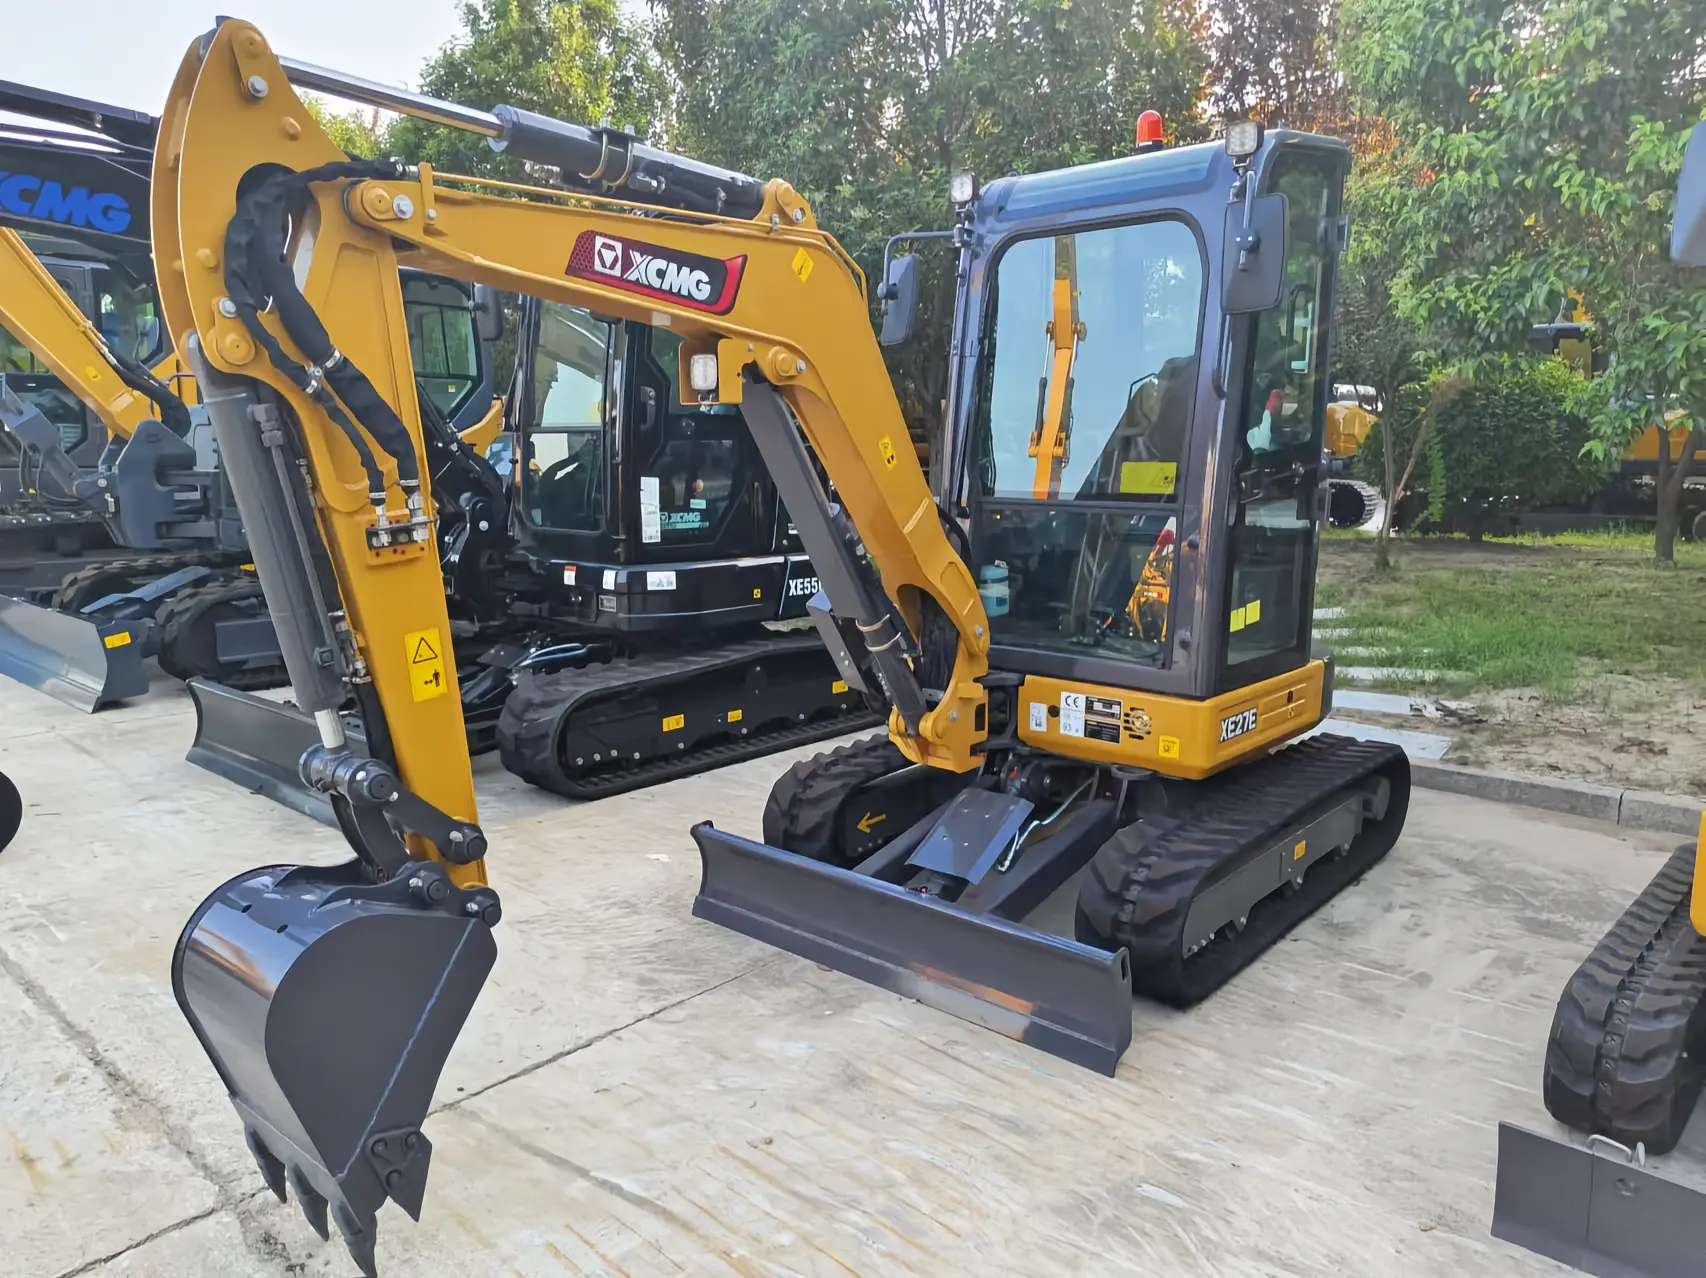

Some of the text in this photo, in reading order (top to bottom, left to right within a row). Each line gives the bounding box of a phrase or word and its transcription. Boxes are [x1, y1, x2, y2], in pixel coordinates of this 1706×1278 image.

[0, 170, 131, 233] CMG
[623, 249, 711, 301] XCMG
[1220, 707, 1257, 742] XE27E
